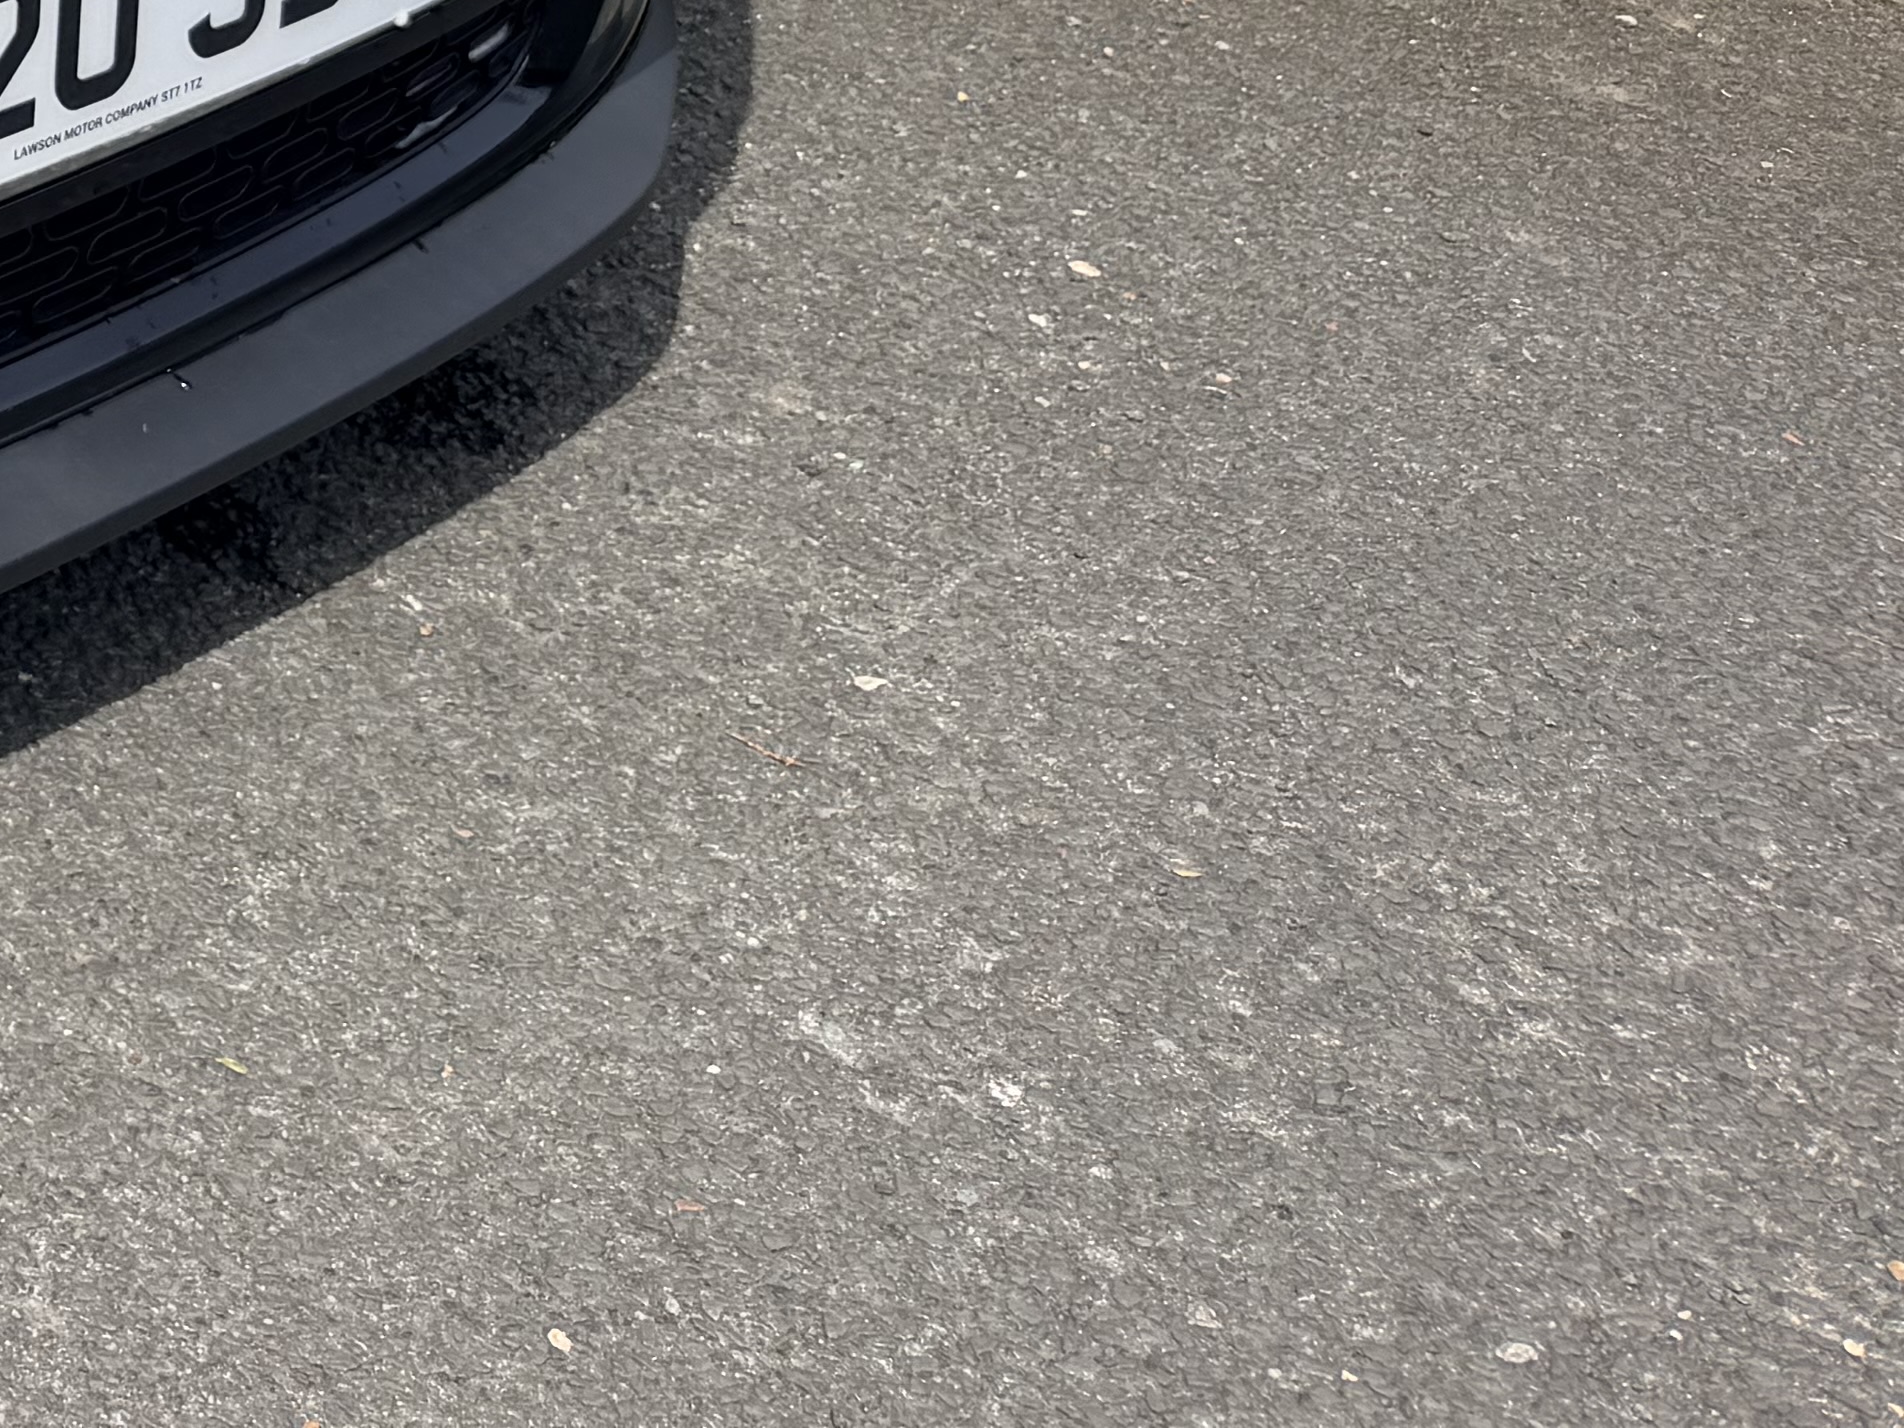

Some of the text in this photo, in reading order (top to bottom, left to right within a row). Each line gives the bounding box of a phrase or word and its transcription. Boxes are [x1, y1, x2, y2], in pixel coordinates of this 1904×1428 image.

[13, 133, 62, 161] LAWSON
[63, 116, 103, 142] MOTOR
[105, 93, 159, 125] COMPANY
